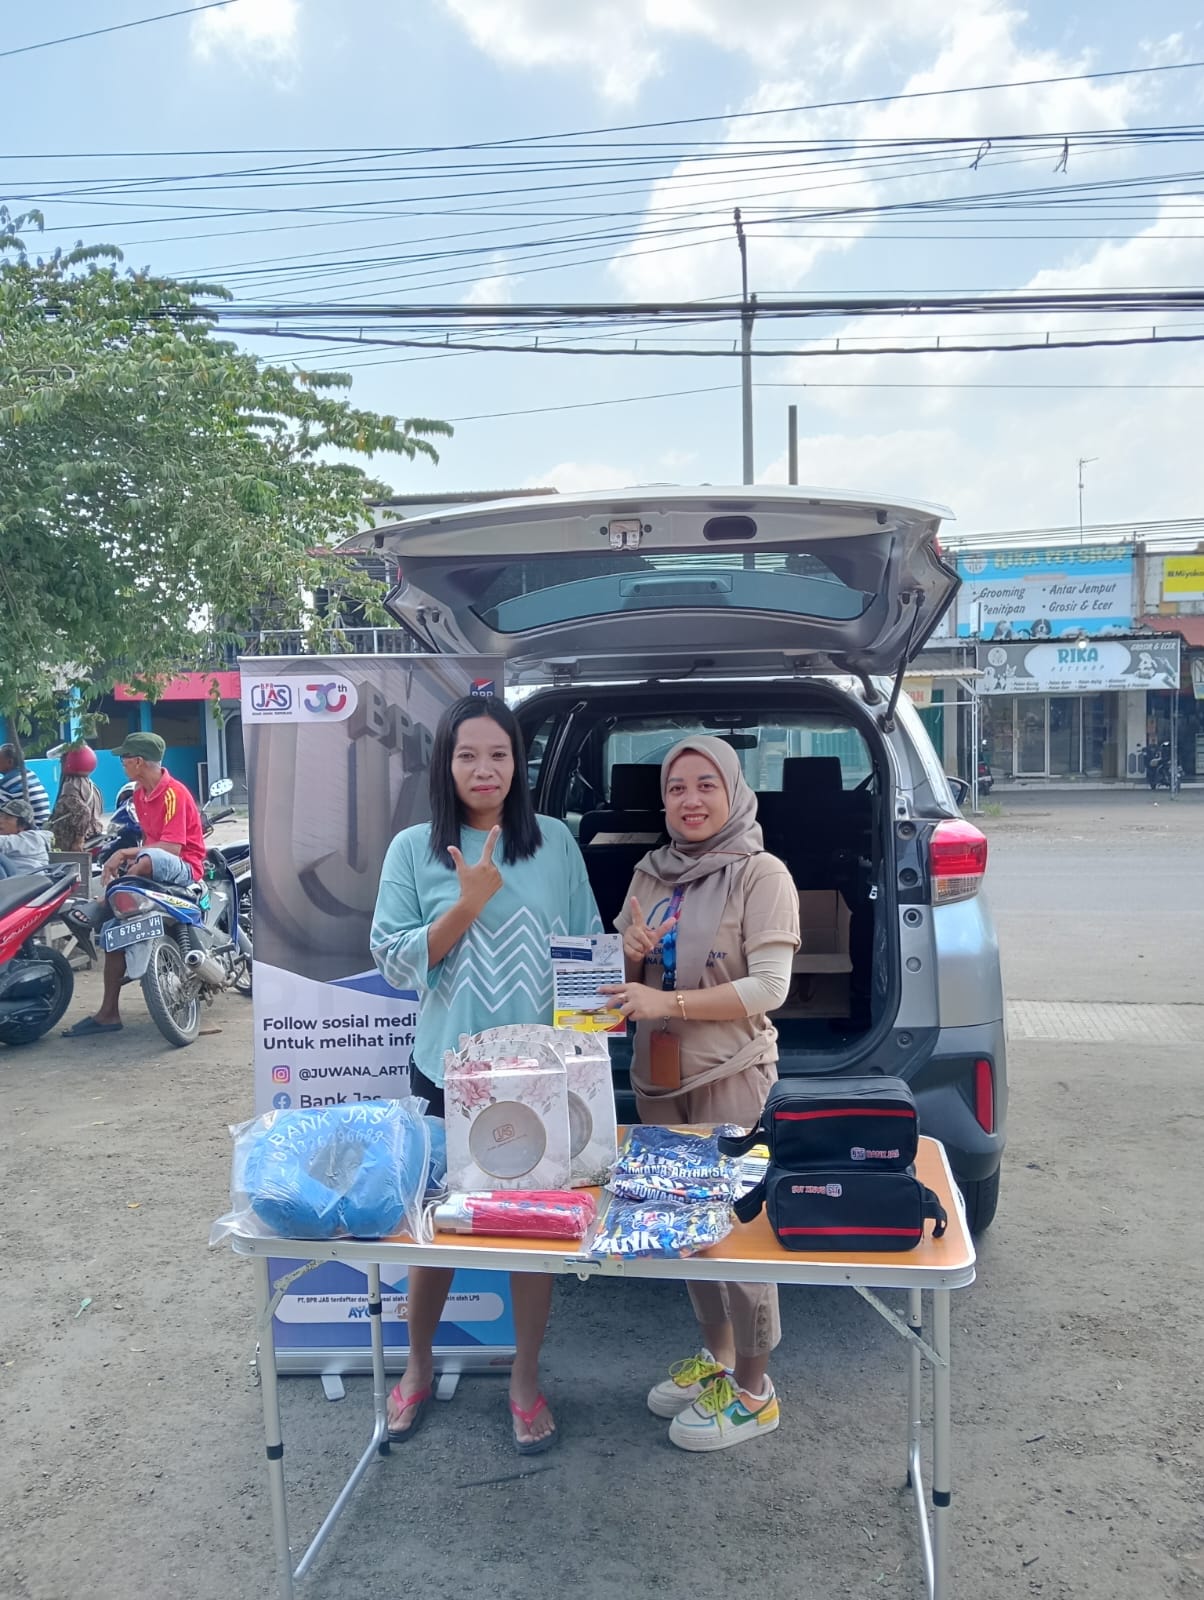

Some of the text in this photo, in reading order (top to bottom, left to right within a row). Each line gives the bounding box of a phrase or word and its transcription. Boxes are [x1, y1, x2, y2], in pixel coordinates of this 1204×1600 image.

[994, 551, 1040, 569] RIKA
[1046, 547, 1126, 565] PETSHOP
[980, 587, 1026, 600] Grooming
[1049, 583, 1117, 595] Antar Jemput
[1048, 599, 1113, 612] Grosir & Ecer
[1057, 648, 1098, 663] RIKA
[255, 689, 288, 708] JAS
[107, 931, 114, 940] K
[263, 1013, 417, 1031] Follow sosial medi
[263, 1036, 316, 1050] Untuk
[319, 1034, 385, 1049] melihat
[298, 1065, 409, 1081] @JUWANA_ART
[300, 1092, 347, 1109] Bank
[268, 1108, 385, 1146] BANK JAS
